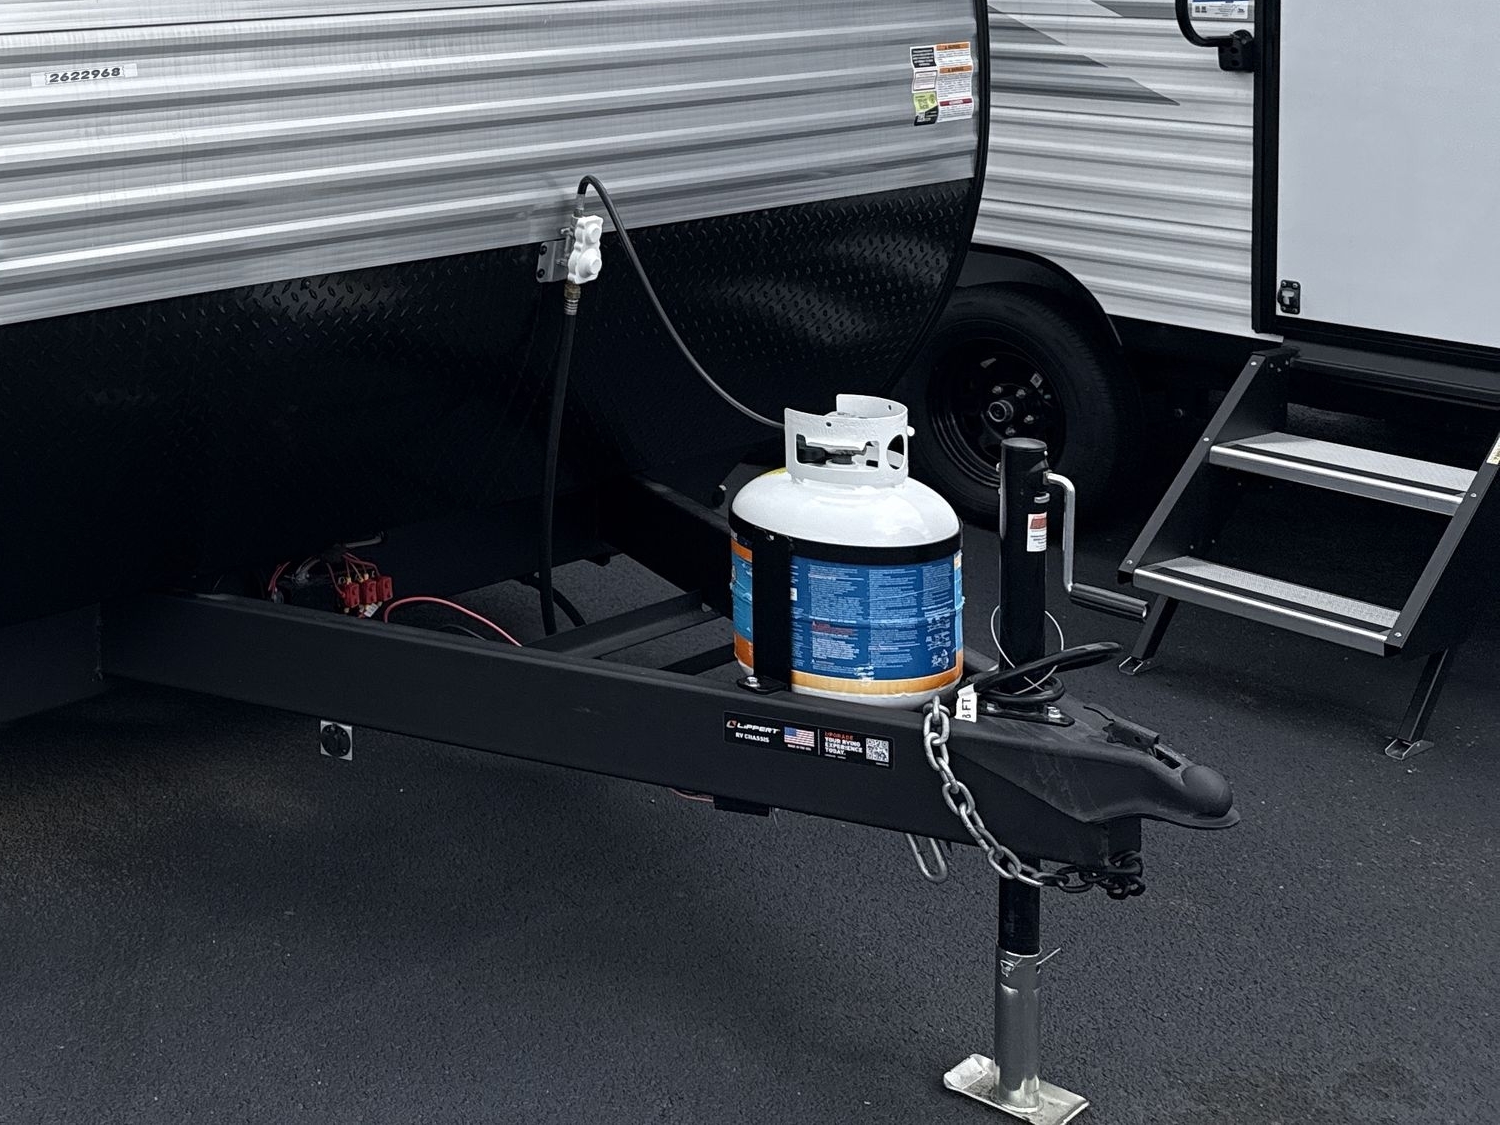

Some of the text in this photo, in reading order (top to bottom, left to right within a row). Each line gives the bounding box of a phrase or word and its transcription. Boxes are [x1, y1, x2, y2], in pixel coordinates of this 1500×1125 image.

[49, 67, 121, 83] 2622968
[961, 698, 971, 711] FT
[737, 723, 780, 734] LIPPERT
